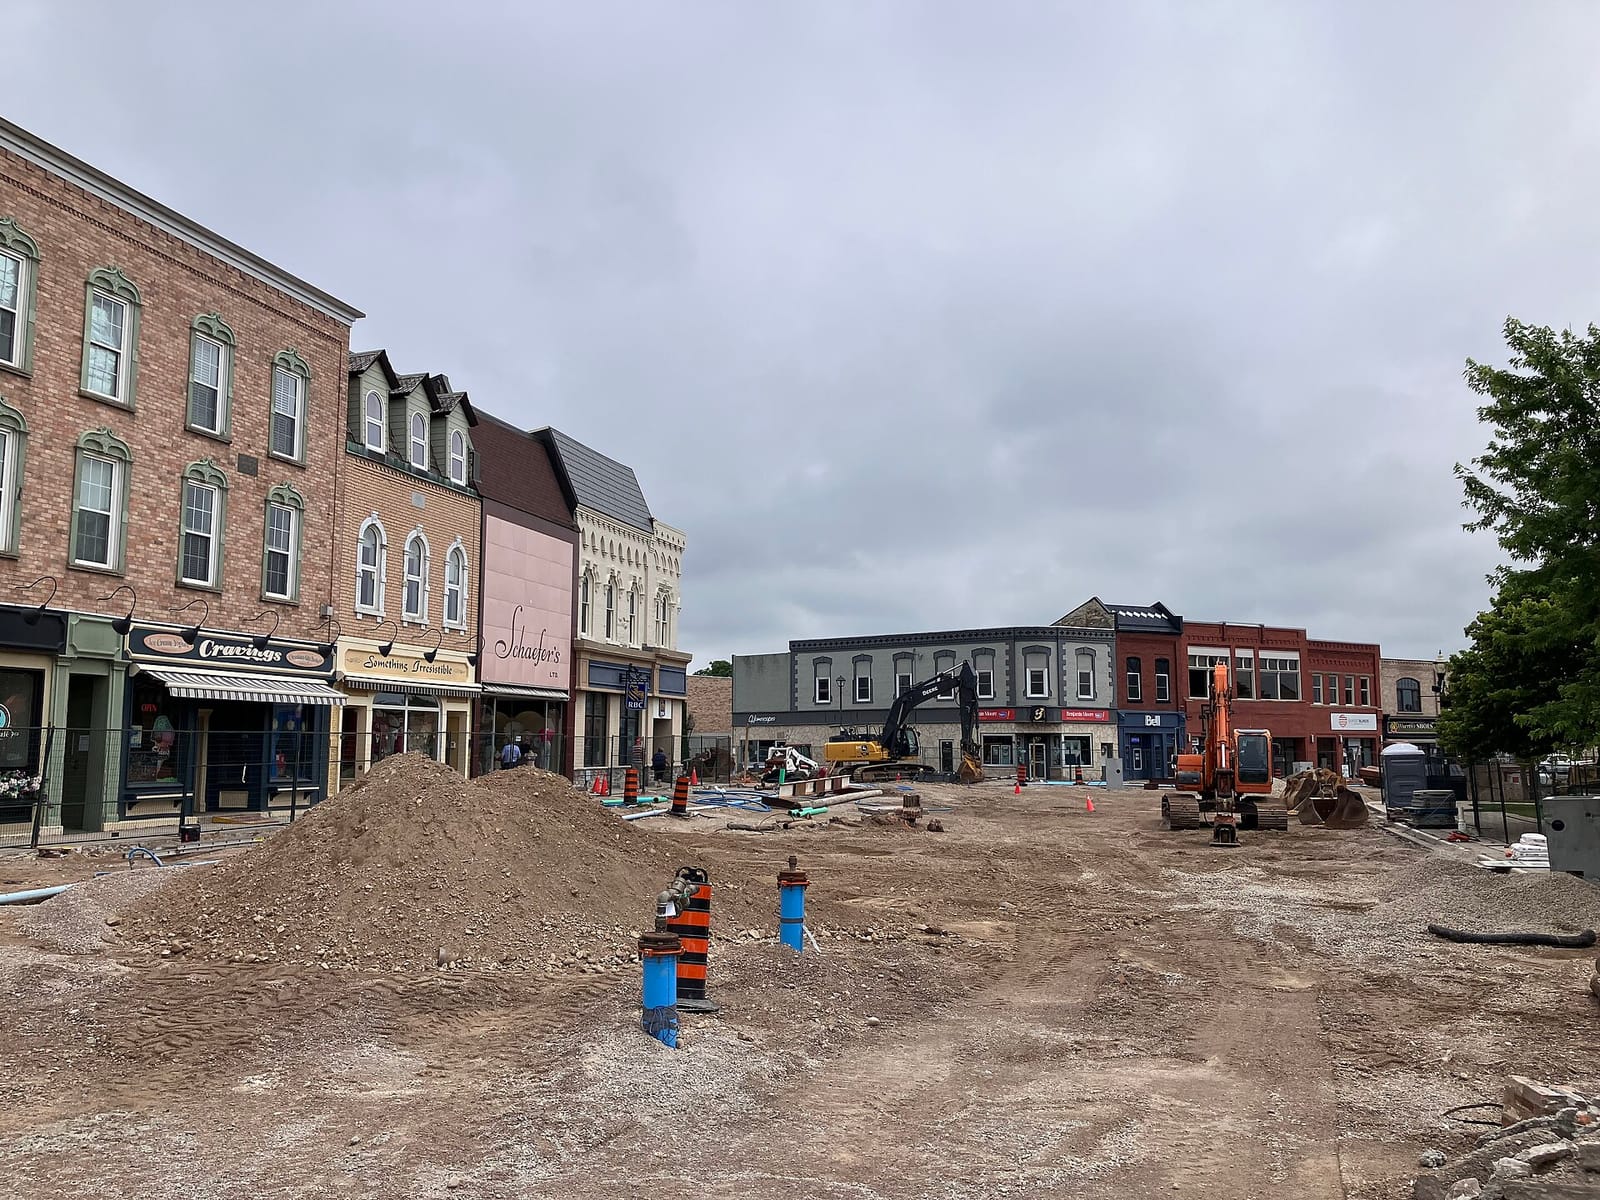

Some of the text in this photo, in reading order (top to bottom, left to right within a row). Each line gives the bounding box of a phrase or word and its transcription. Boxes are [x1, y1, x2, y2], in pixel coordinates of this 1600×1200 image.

[495, 604, 561, 667] Schaefer's
[199, 639, 282, 662] Cravings
[363, 655, 453, 675] Something Irresistible
[628, 701, 643, 709] RBC
[1144, 715, 1161, 727] Bell
